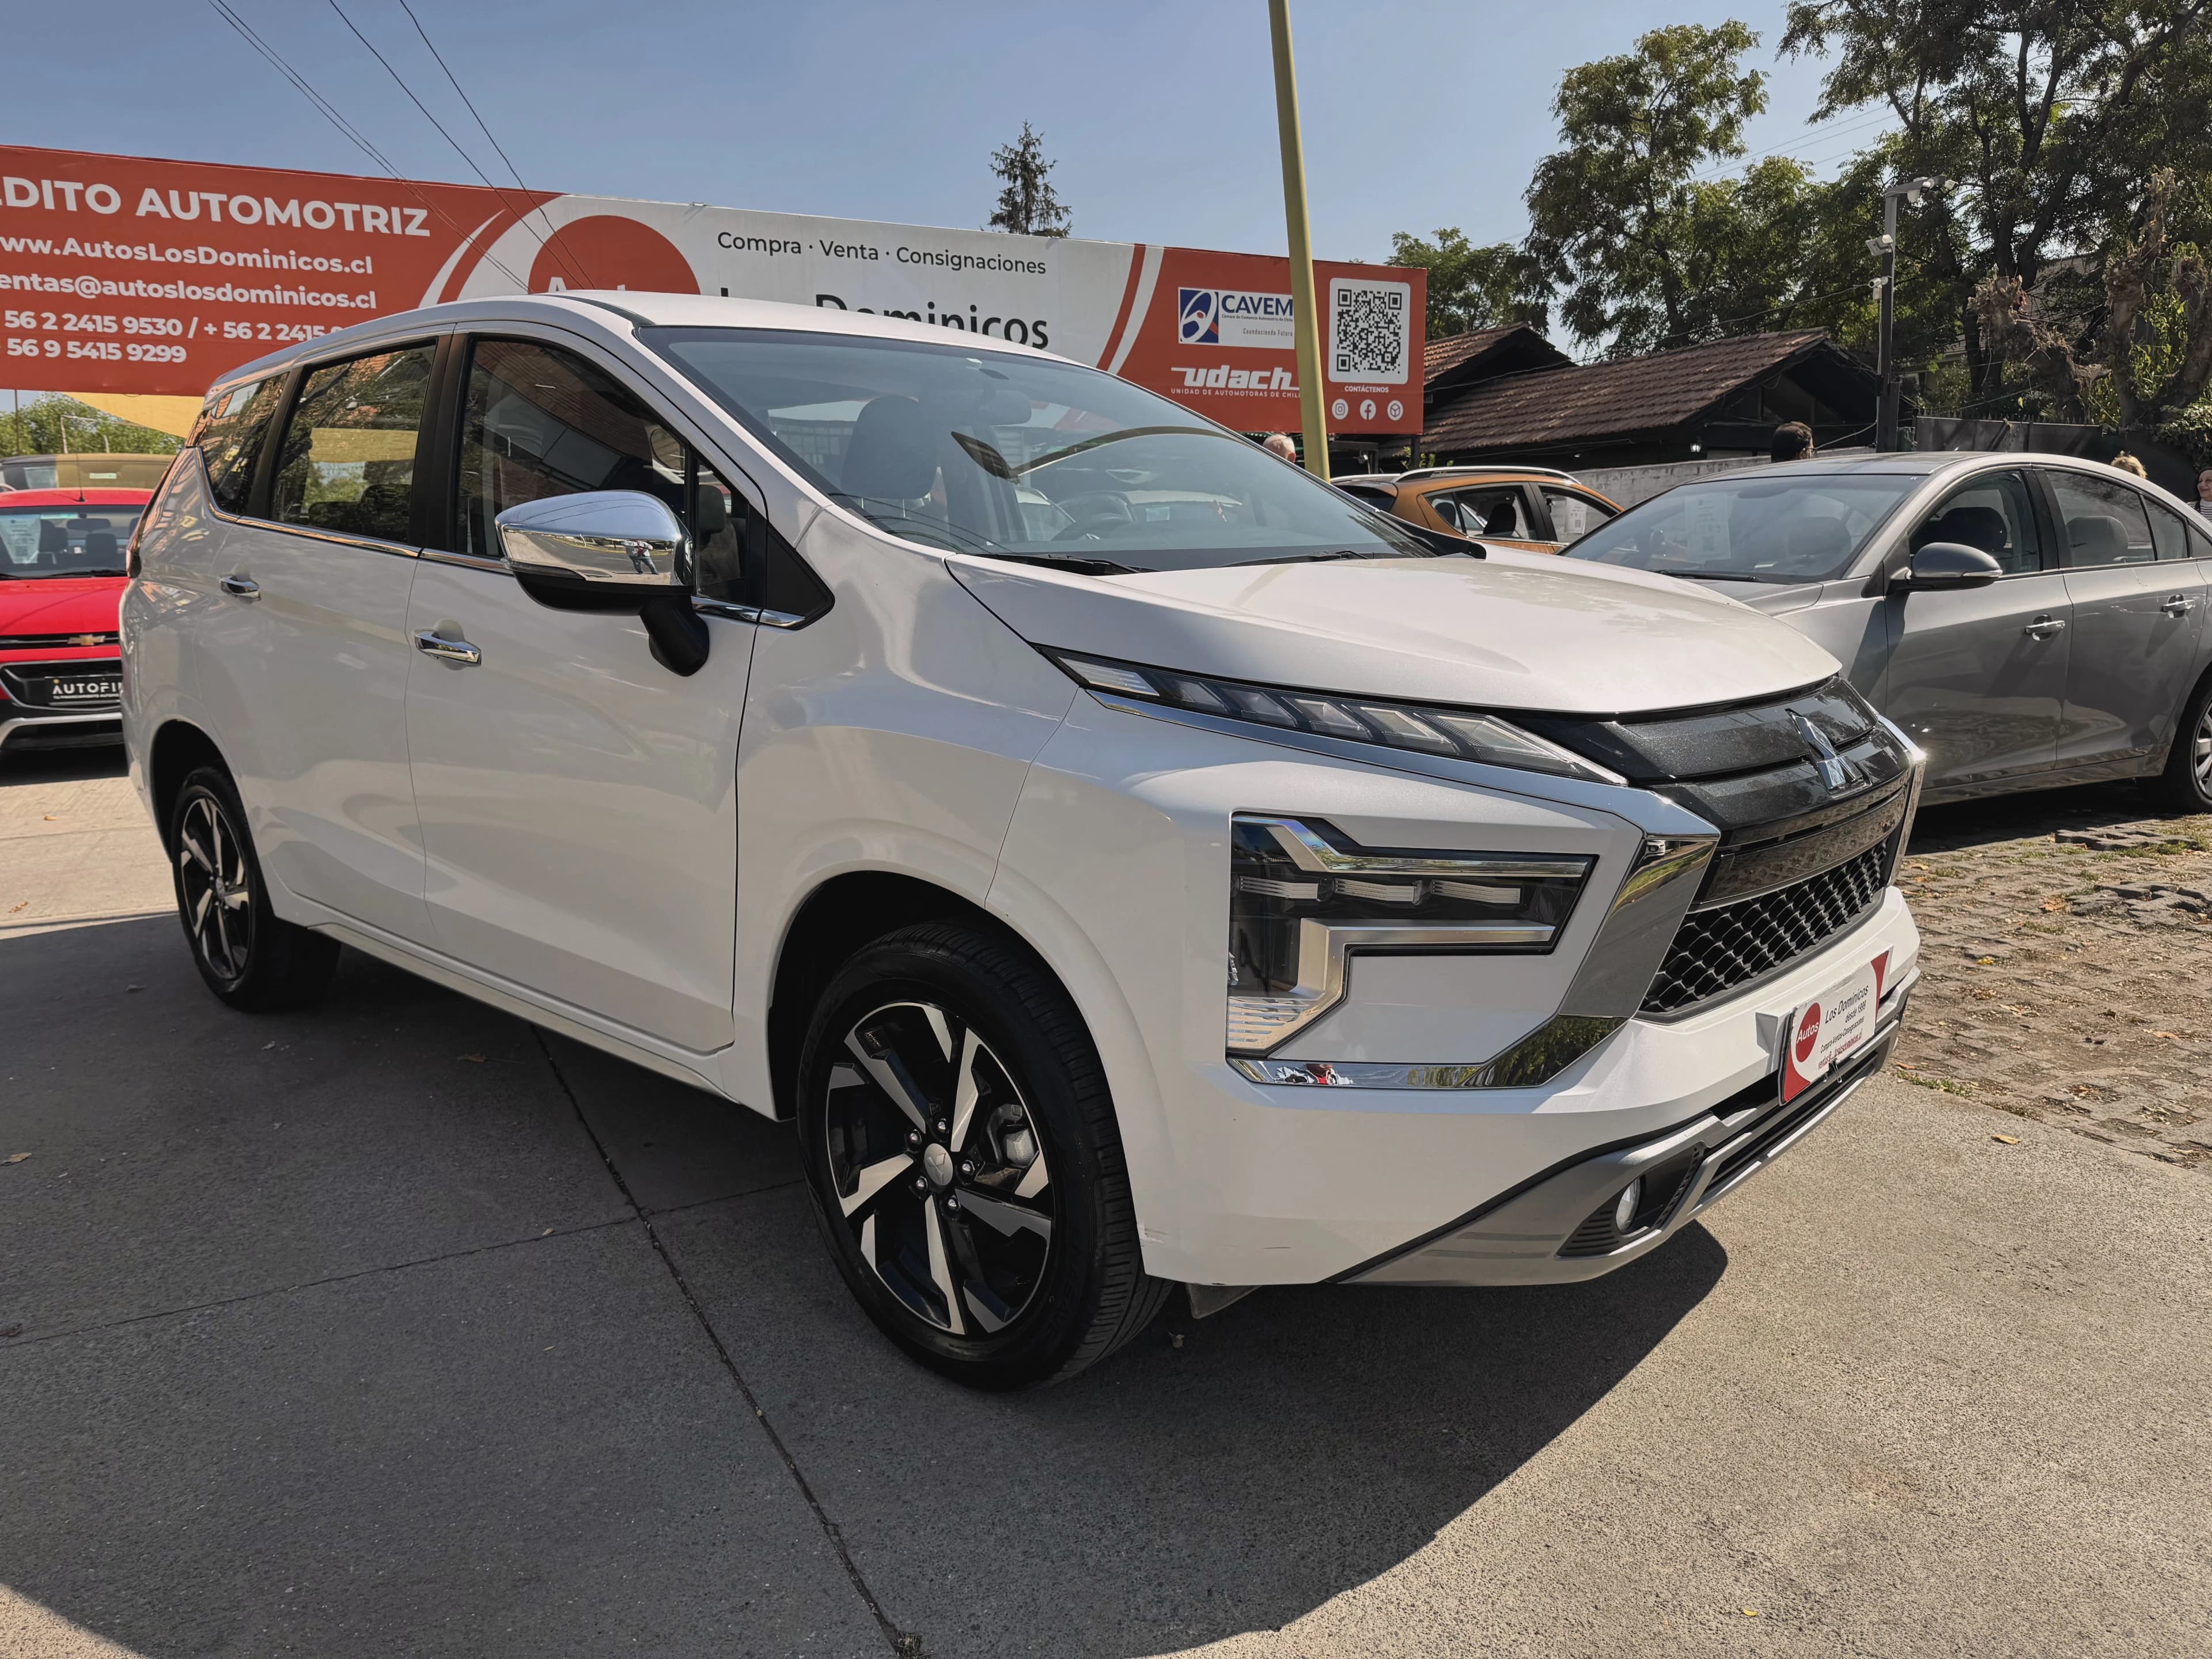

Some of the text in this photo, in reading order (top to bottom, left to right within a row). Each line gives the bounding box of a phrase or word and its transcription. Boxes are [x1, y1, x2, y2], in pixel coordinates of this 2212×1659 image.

[0, 176, 430, 237] DITO AUTOMOTRIZ
[717, 232, 802, 256] Compra
[820, 240, 879, 260] Venta
[897, 247, 1047, 274] Consignaciones
[1221, 295, 1293, 316] CAVEM
[5, 310, 37, 329] 56
[40, 312, 58, 330] 2
[62, 313, 119, 334] 2415
[122, 317, 183, 336] 9530
[224, 321, 252, 339] 56
[256, 323, 272, 340] 2
[7, 338, 187, 363] 56 9 5415 9299
[1214, 389, 1268, 397] AUTOMOTORAS
[1344, 385, 1389, 393] CONTÁCTENOS
[1825, 985, 1869, 1024] Los Dominicos
[1845, 999, 1867, 1024] desde 1999
[1797, 1022, 1820, 1044] Autos
